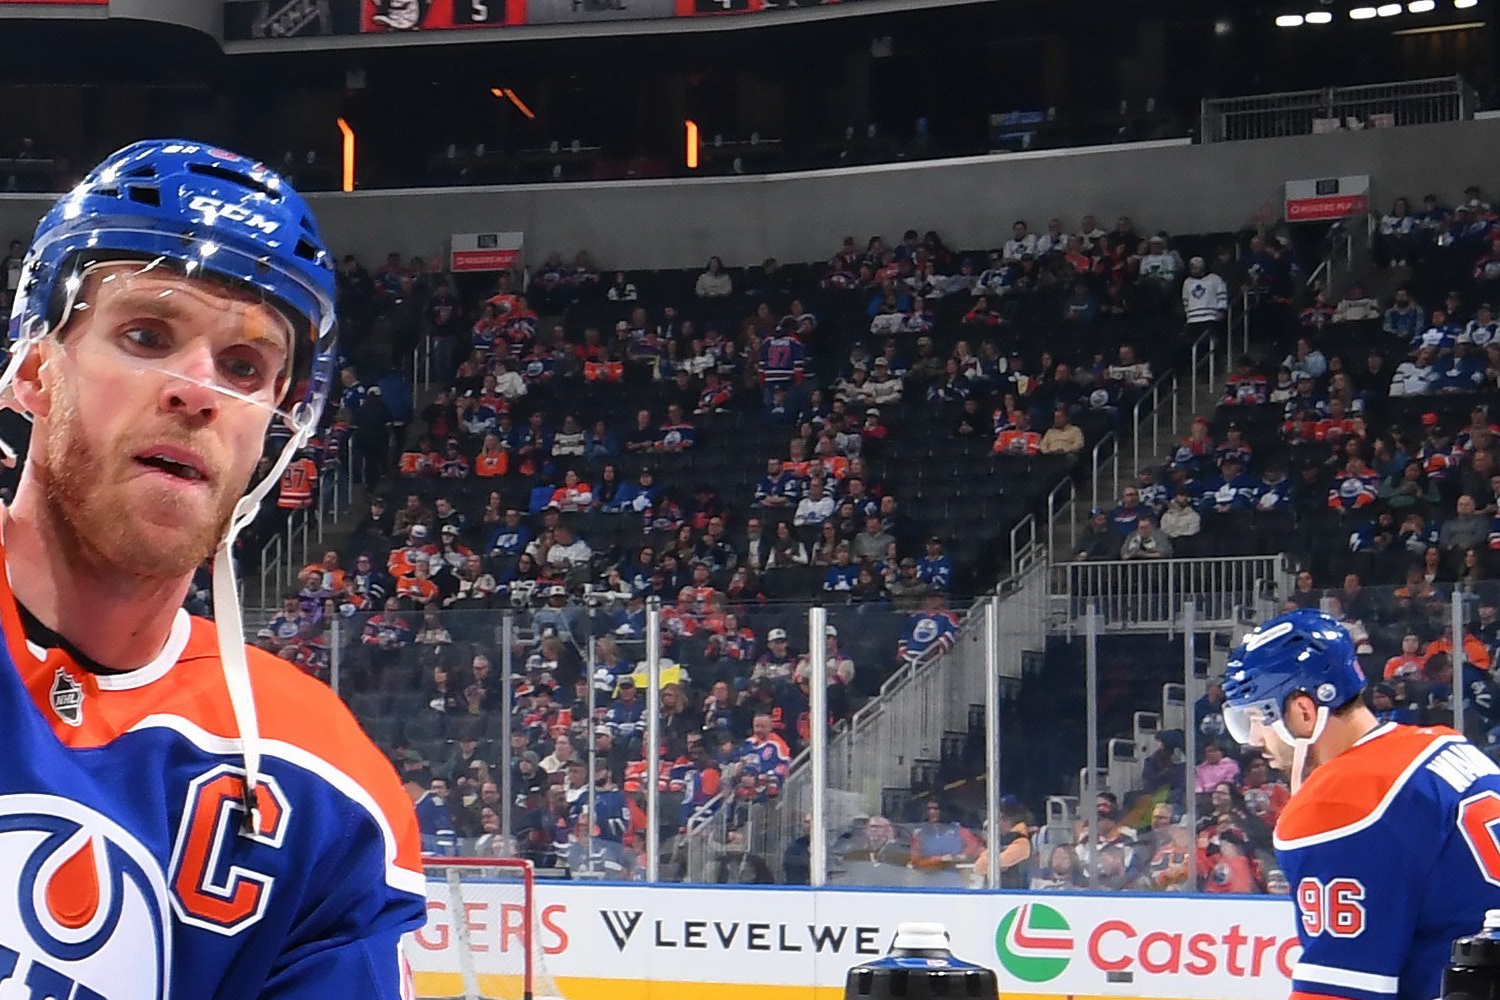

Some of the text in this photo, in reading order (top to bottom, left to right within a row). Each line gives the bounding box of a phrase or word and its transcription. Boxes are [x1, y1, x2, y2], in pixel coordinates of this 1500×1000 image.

[167, 763, 293, 937] C
[655, 920, 898, 954] LEVELWE
[1297, 877, 1366, 938] 96
